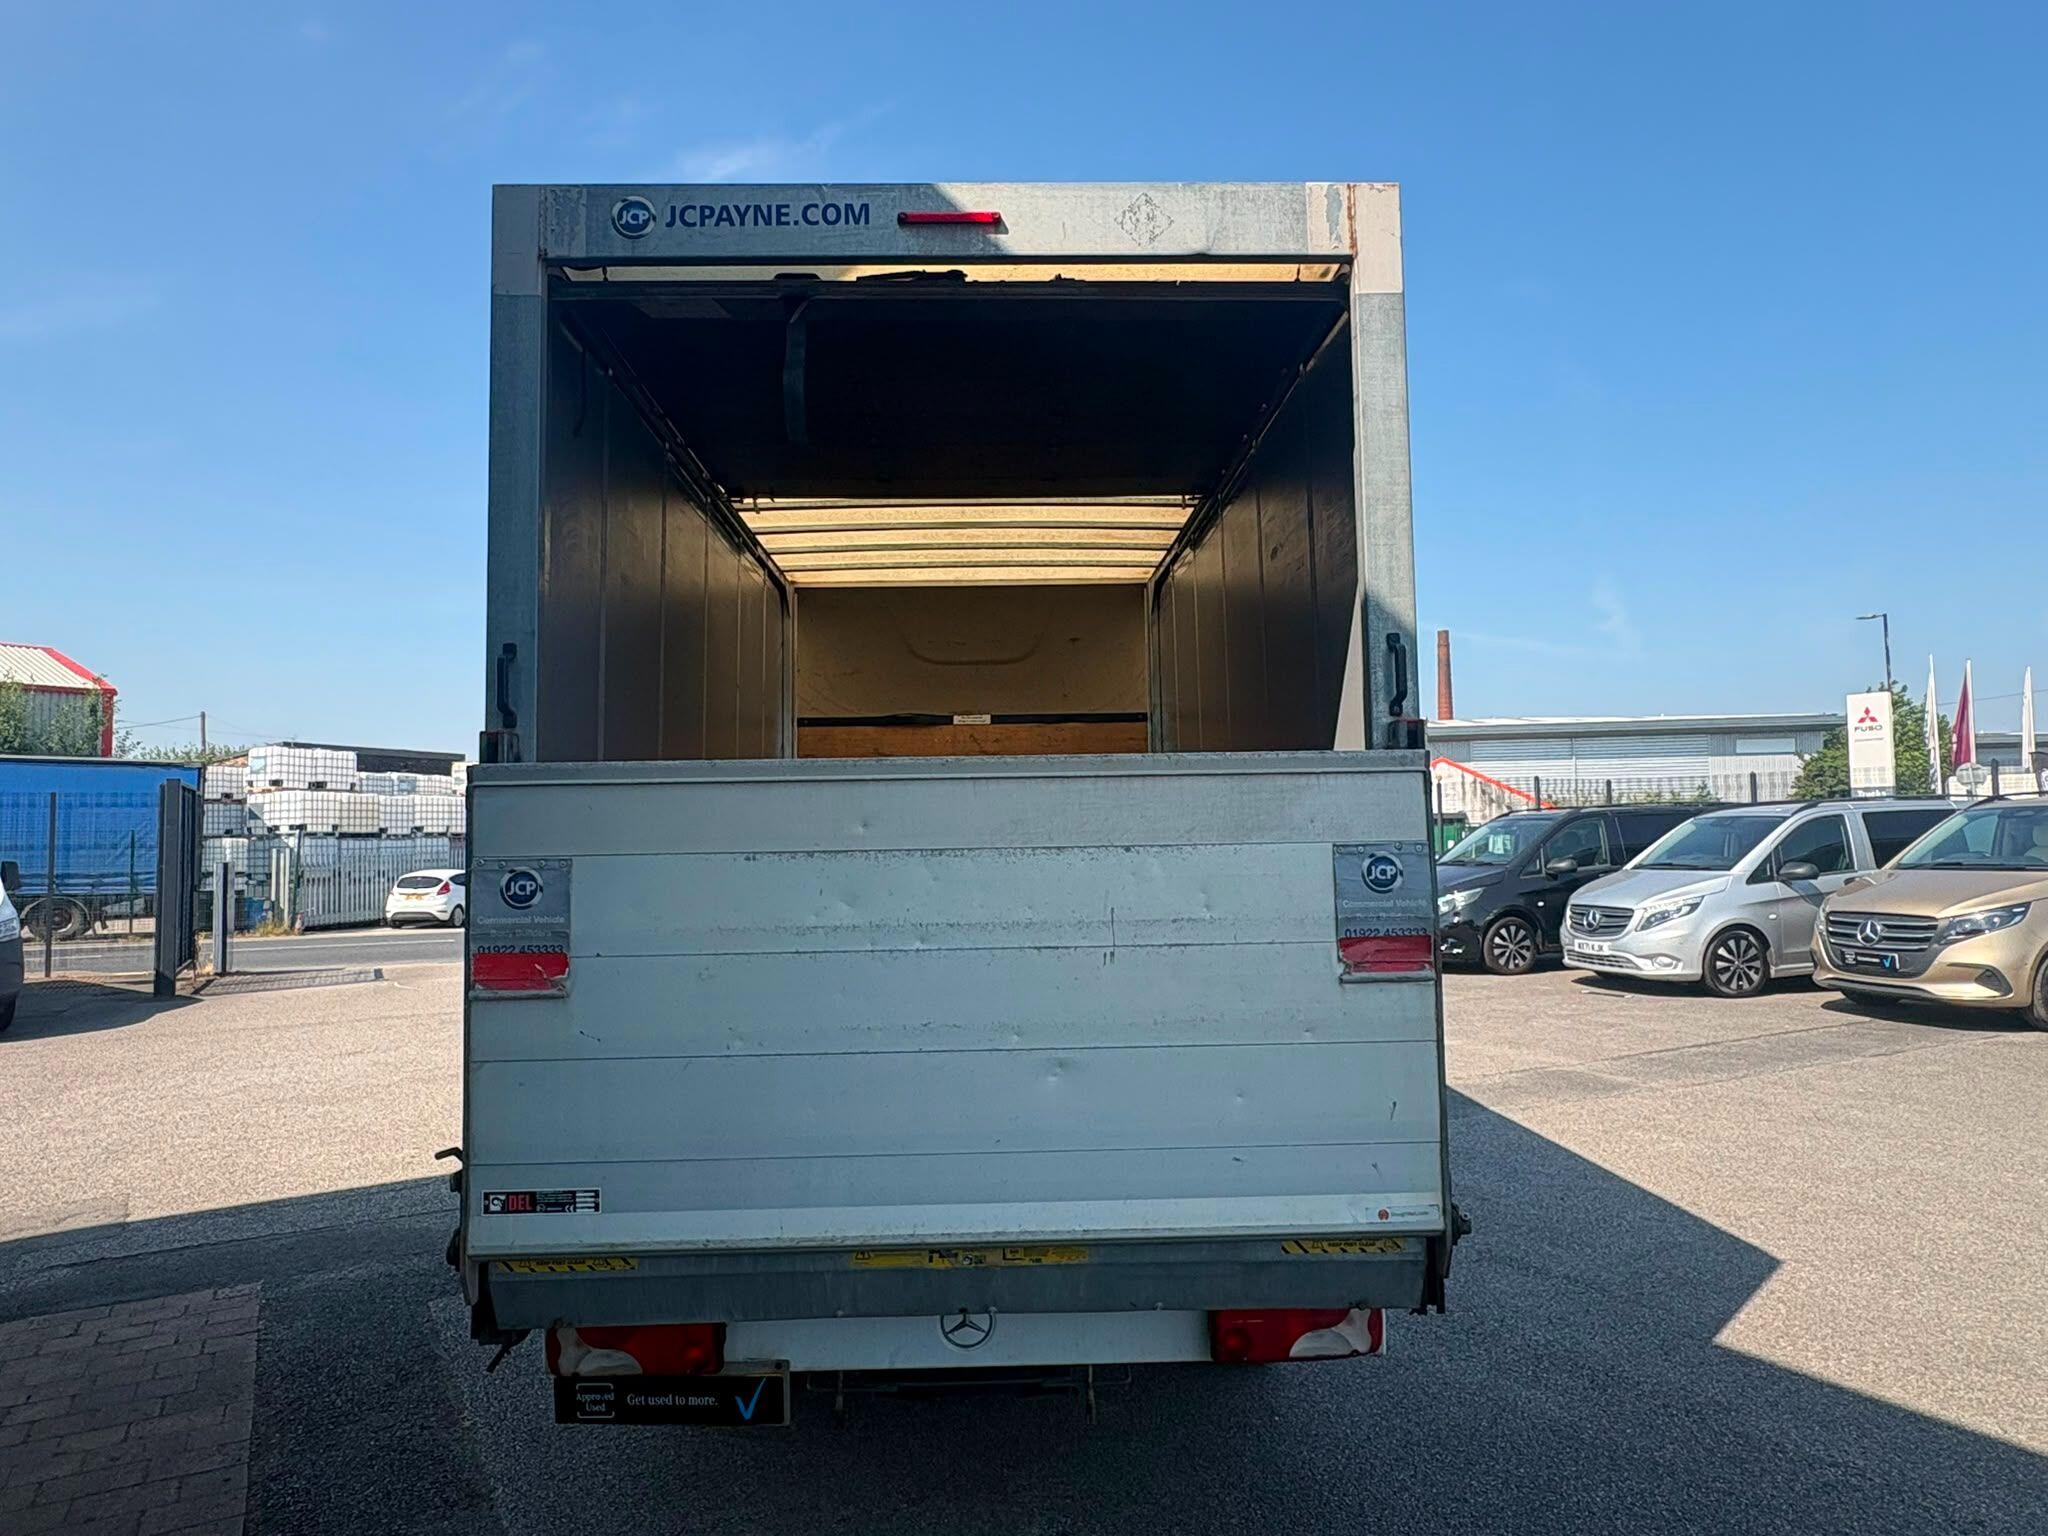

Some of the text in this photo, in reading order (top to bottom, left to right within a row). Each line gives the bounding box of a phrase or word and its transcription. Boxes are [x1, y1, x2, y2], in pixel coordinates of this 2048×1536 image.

[620, 210, 649, 225] JCP
[665, 203, 870, 228] JCPAYNE.COM
[1369, 866, 1396, 879] JCP
[507, 881, 536, 895] JCP
[508, 1194, 534, 1211] DEL
[627, 1393, 718, 1405] Get used to more.
